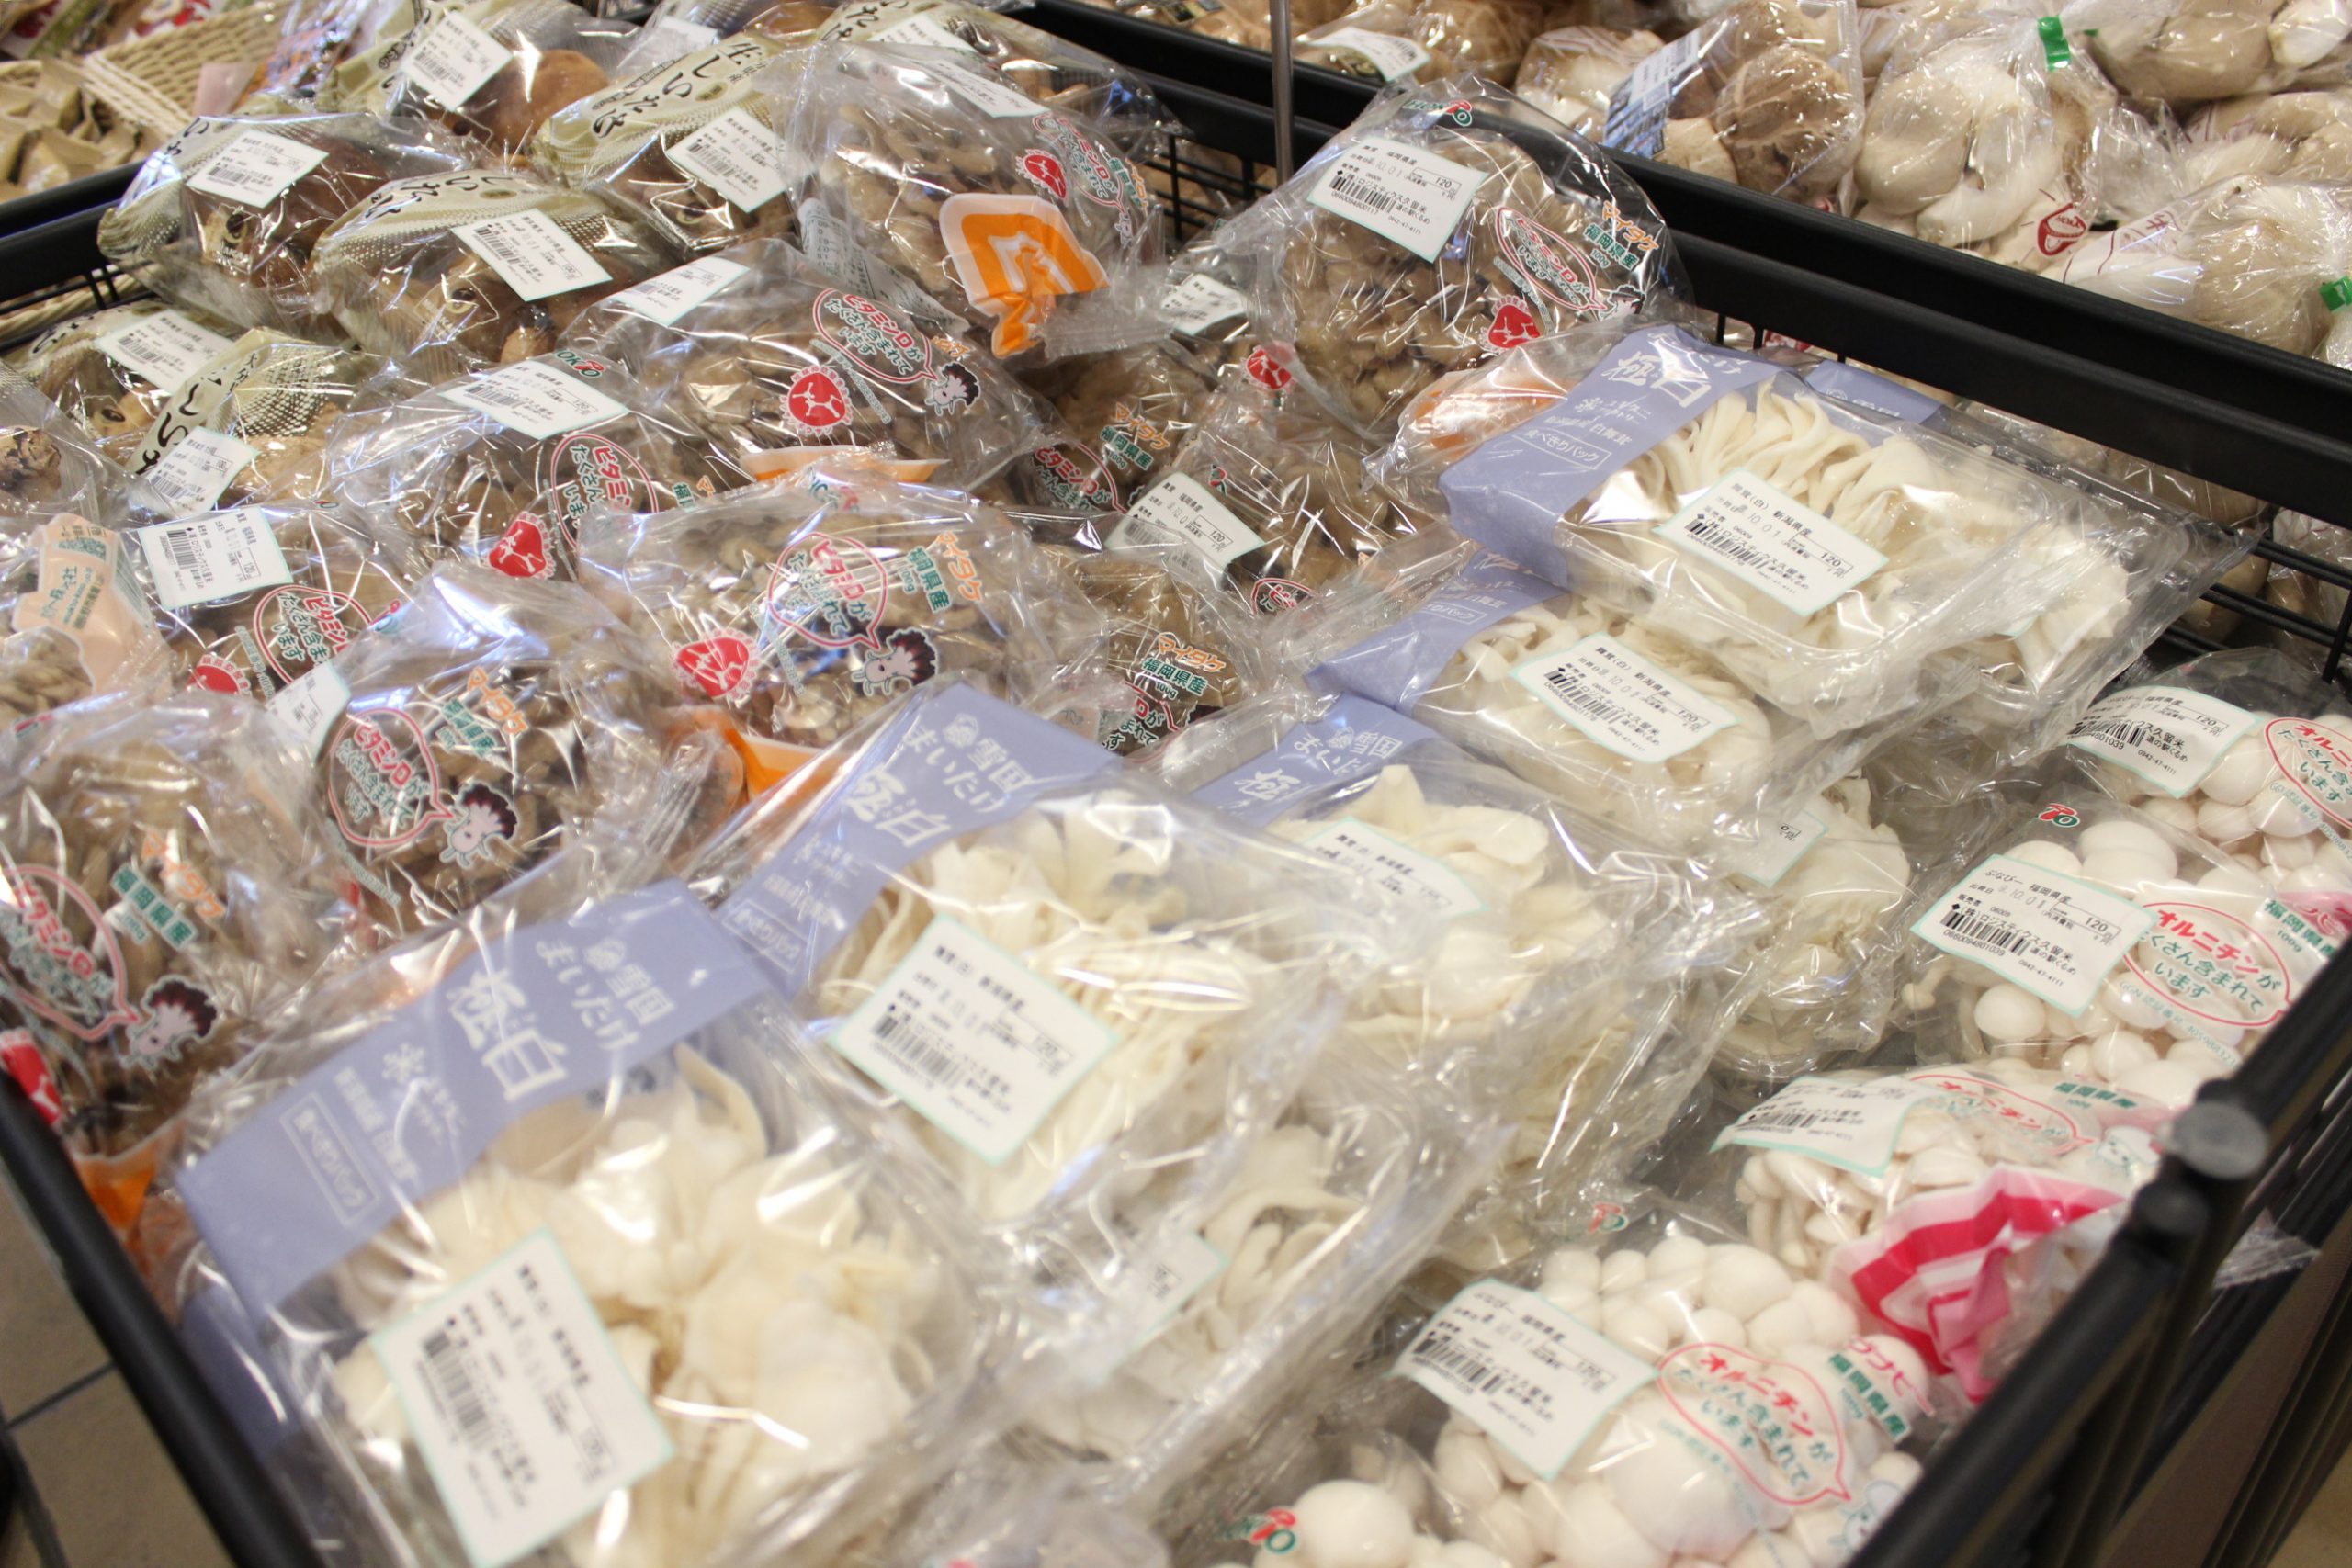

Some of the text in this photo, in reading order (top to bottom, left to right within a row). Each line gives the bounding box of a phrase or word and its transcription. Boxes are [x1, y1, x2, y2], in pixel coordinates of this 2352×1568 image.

[1158, 635, 1227, 673] マイタケ
[1142, 657, 1209, 697] 福岡県産
[1155, 682, 1179, 700] 100g
[2145, 735, 2188, 763] 道の駅くるめ
[1957, 893, 1984, 908] 販売者
[2029, 883, 2073, 905] 福岡県産
[1942, 928, 2007, 957] 0660094801039
[1959, 906, 2075, 964] (株)ロジスティクス久留米
[2157, 909, 2282, 991] オルニチンが
[2029, 946, 2077, 976] 道の駅くるめ
[534, 937, 641, 1053] まいたけ
[2154, 961, 2211, 998] います
